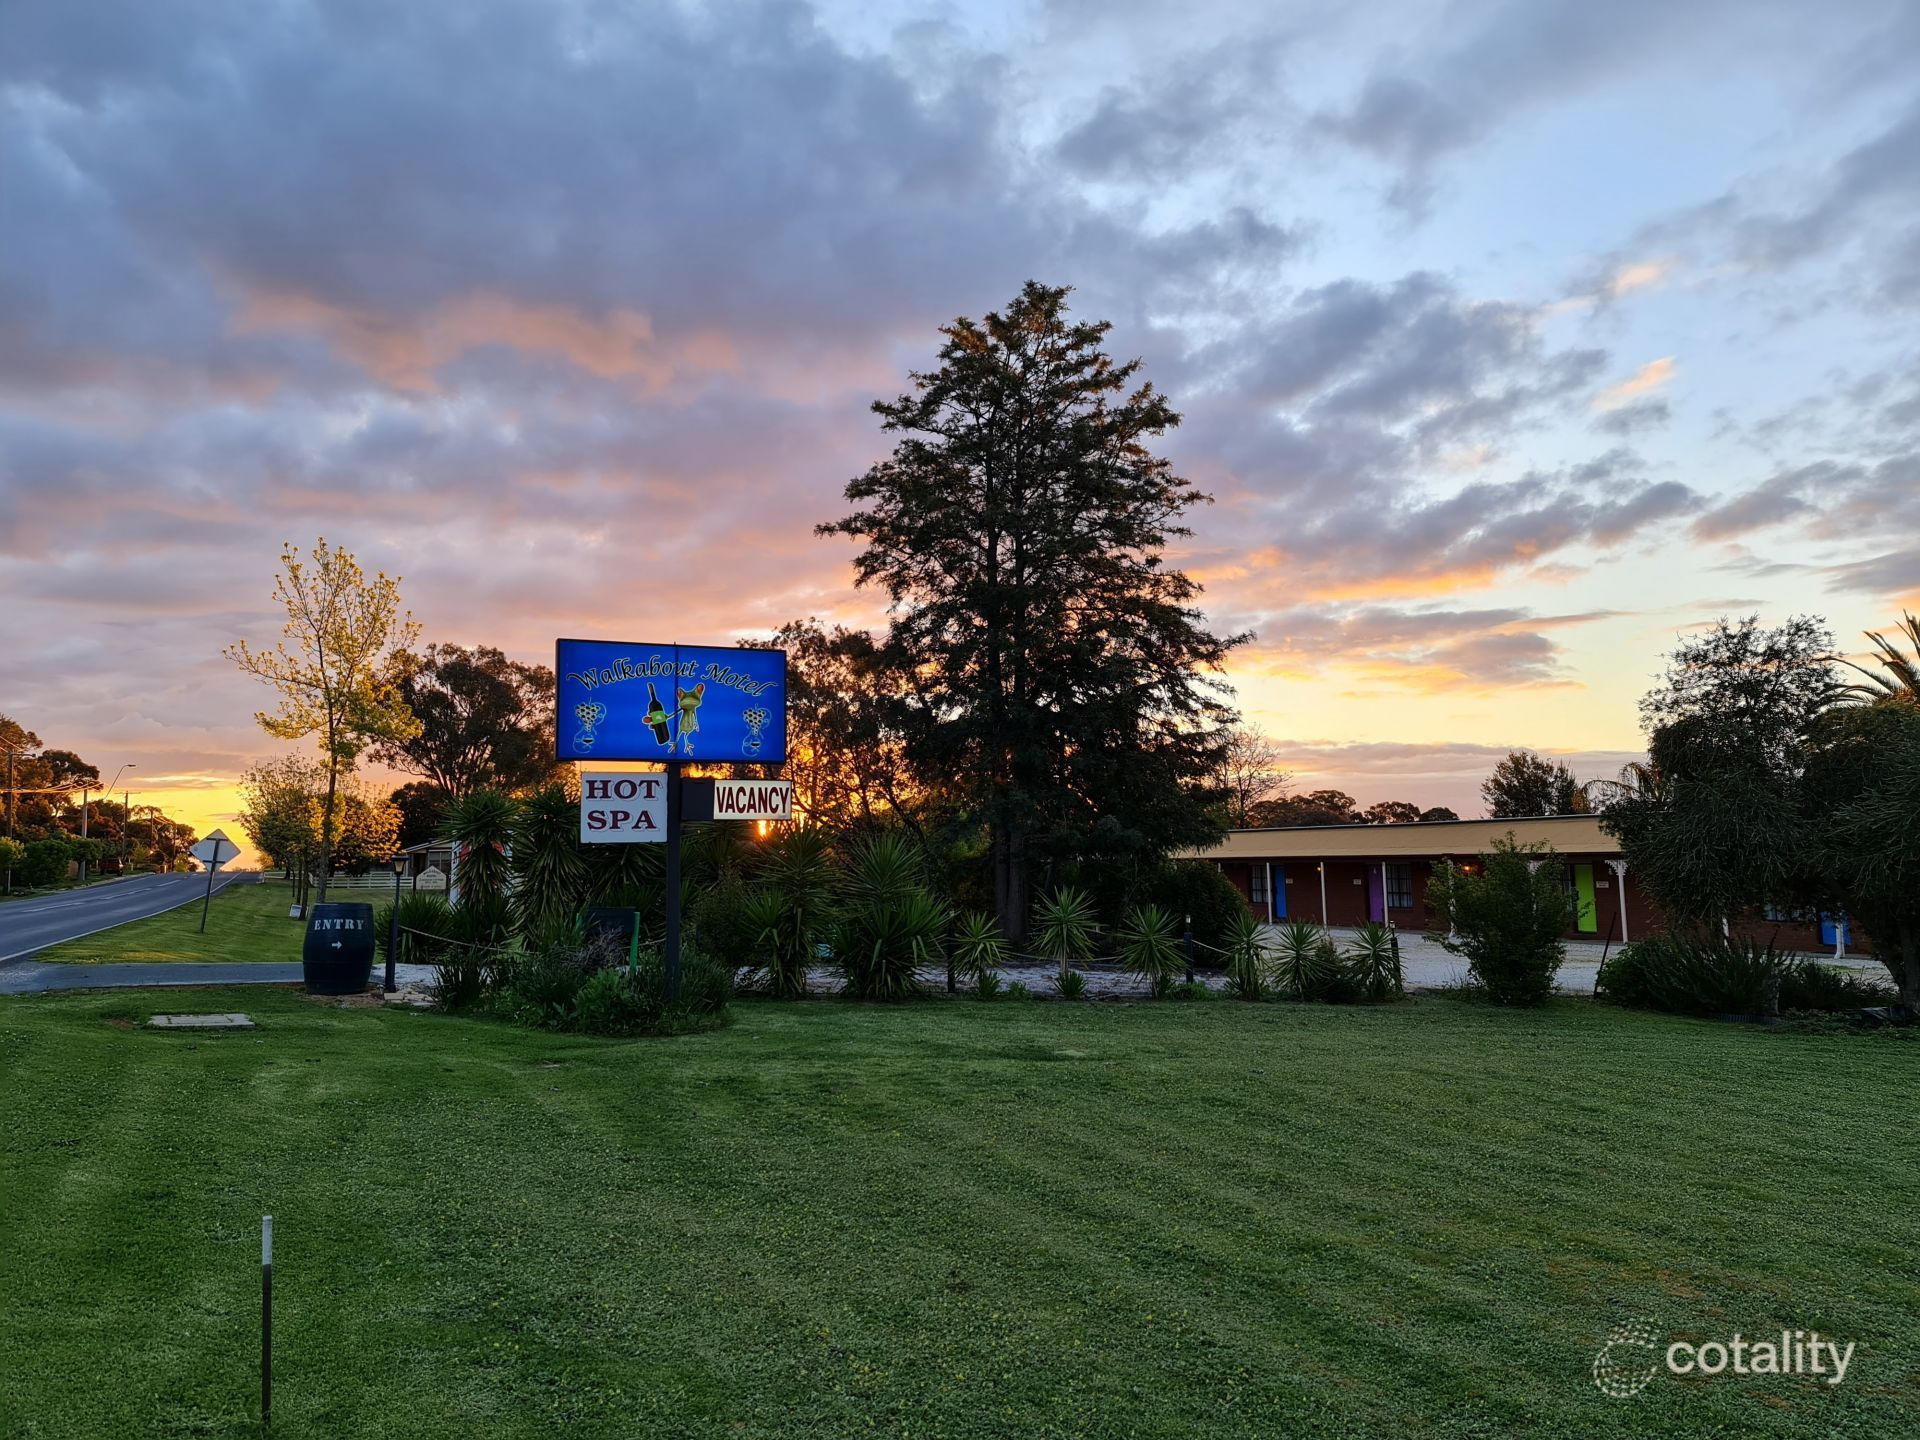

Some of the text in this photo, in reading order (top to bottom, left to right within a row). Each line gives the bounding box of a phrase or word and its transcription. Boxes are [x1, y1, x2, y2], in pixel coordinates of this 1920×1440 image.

[566, 655, 779, 697] Walkabout Motel
[586, 779, 661, 800] HOT
[716, 786, 790, 814] VACANCY
[587, 810, 658, 830] SPA
[314, 918, 364, 931] ENTRY
